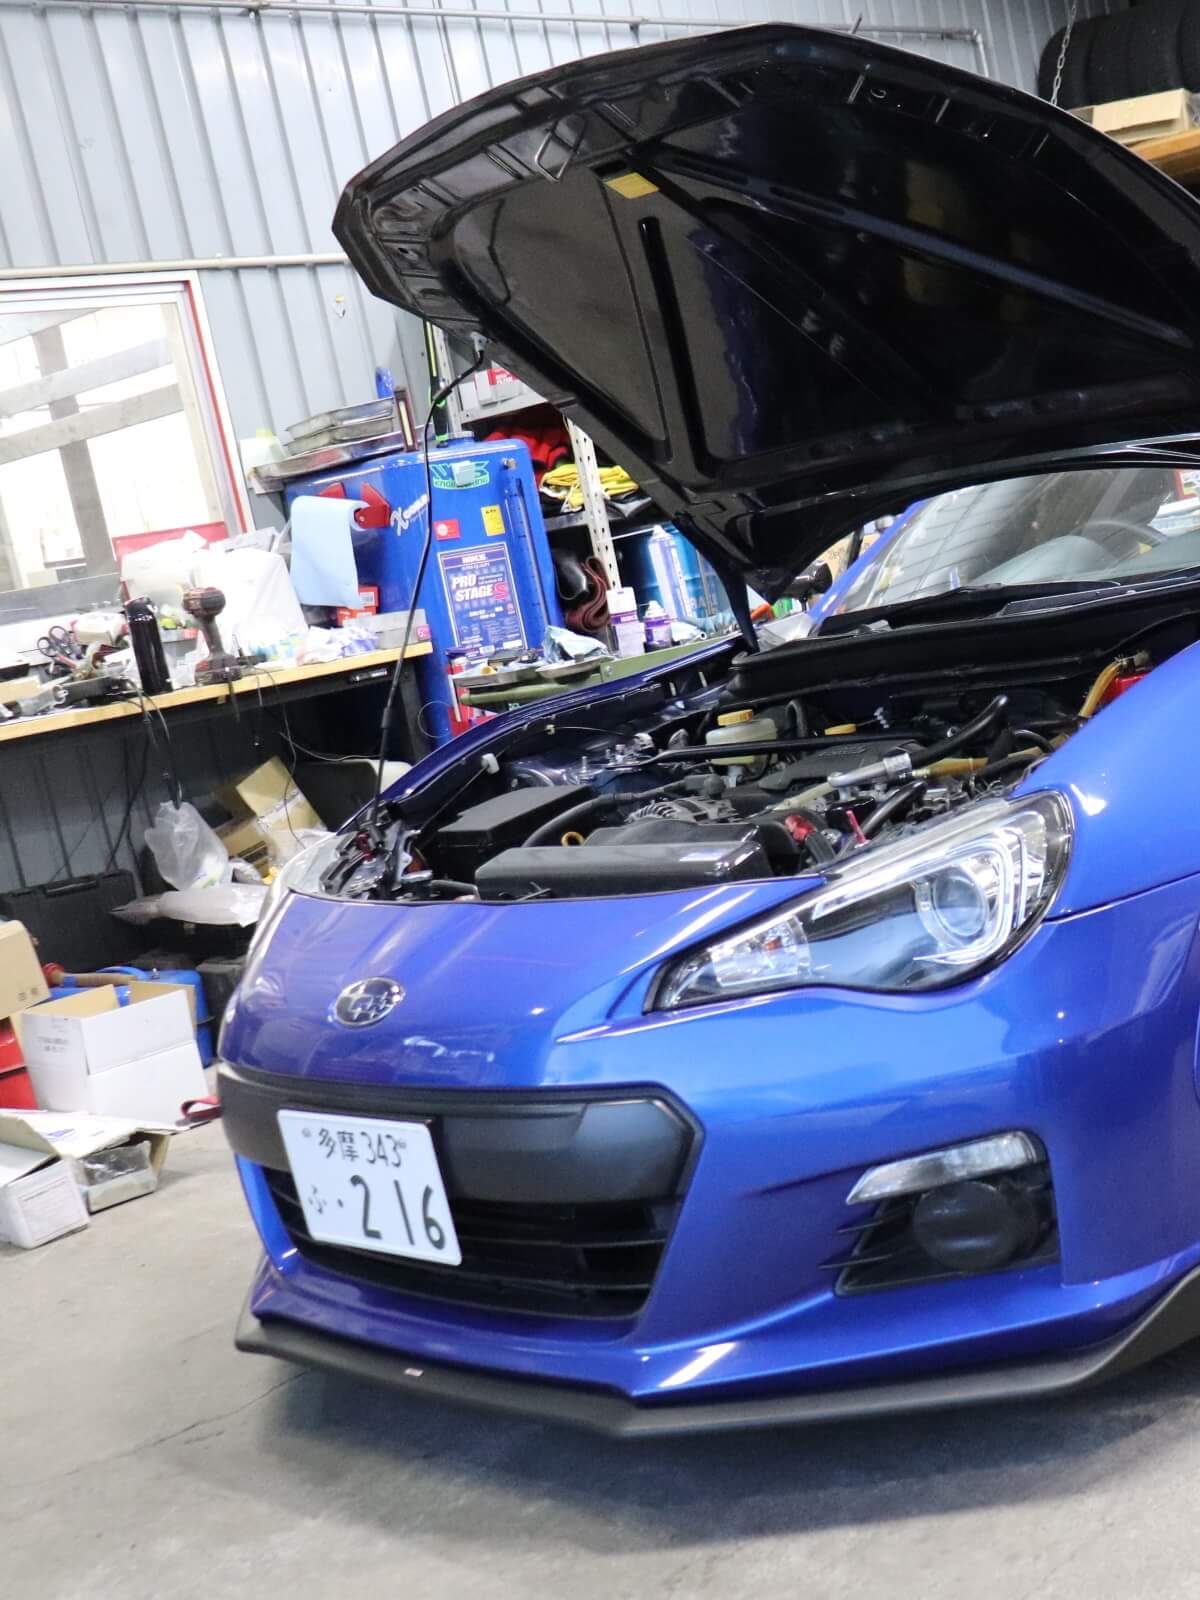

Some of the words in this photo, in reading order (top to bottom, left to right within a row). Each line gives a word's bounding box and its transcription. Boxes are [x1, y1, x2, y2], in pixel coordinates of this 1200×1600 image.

[451, 574, 478, 590] PRO
[455, 583, 495, 603] STAGE
[318, 1128, 360, 1162] 多摩
[360, 1131, 402, 1168] 343
